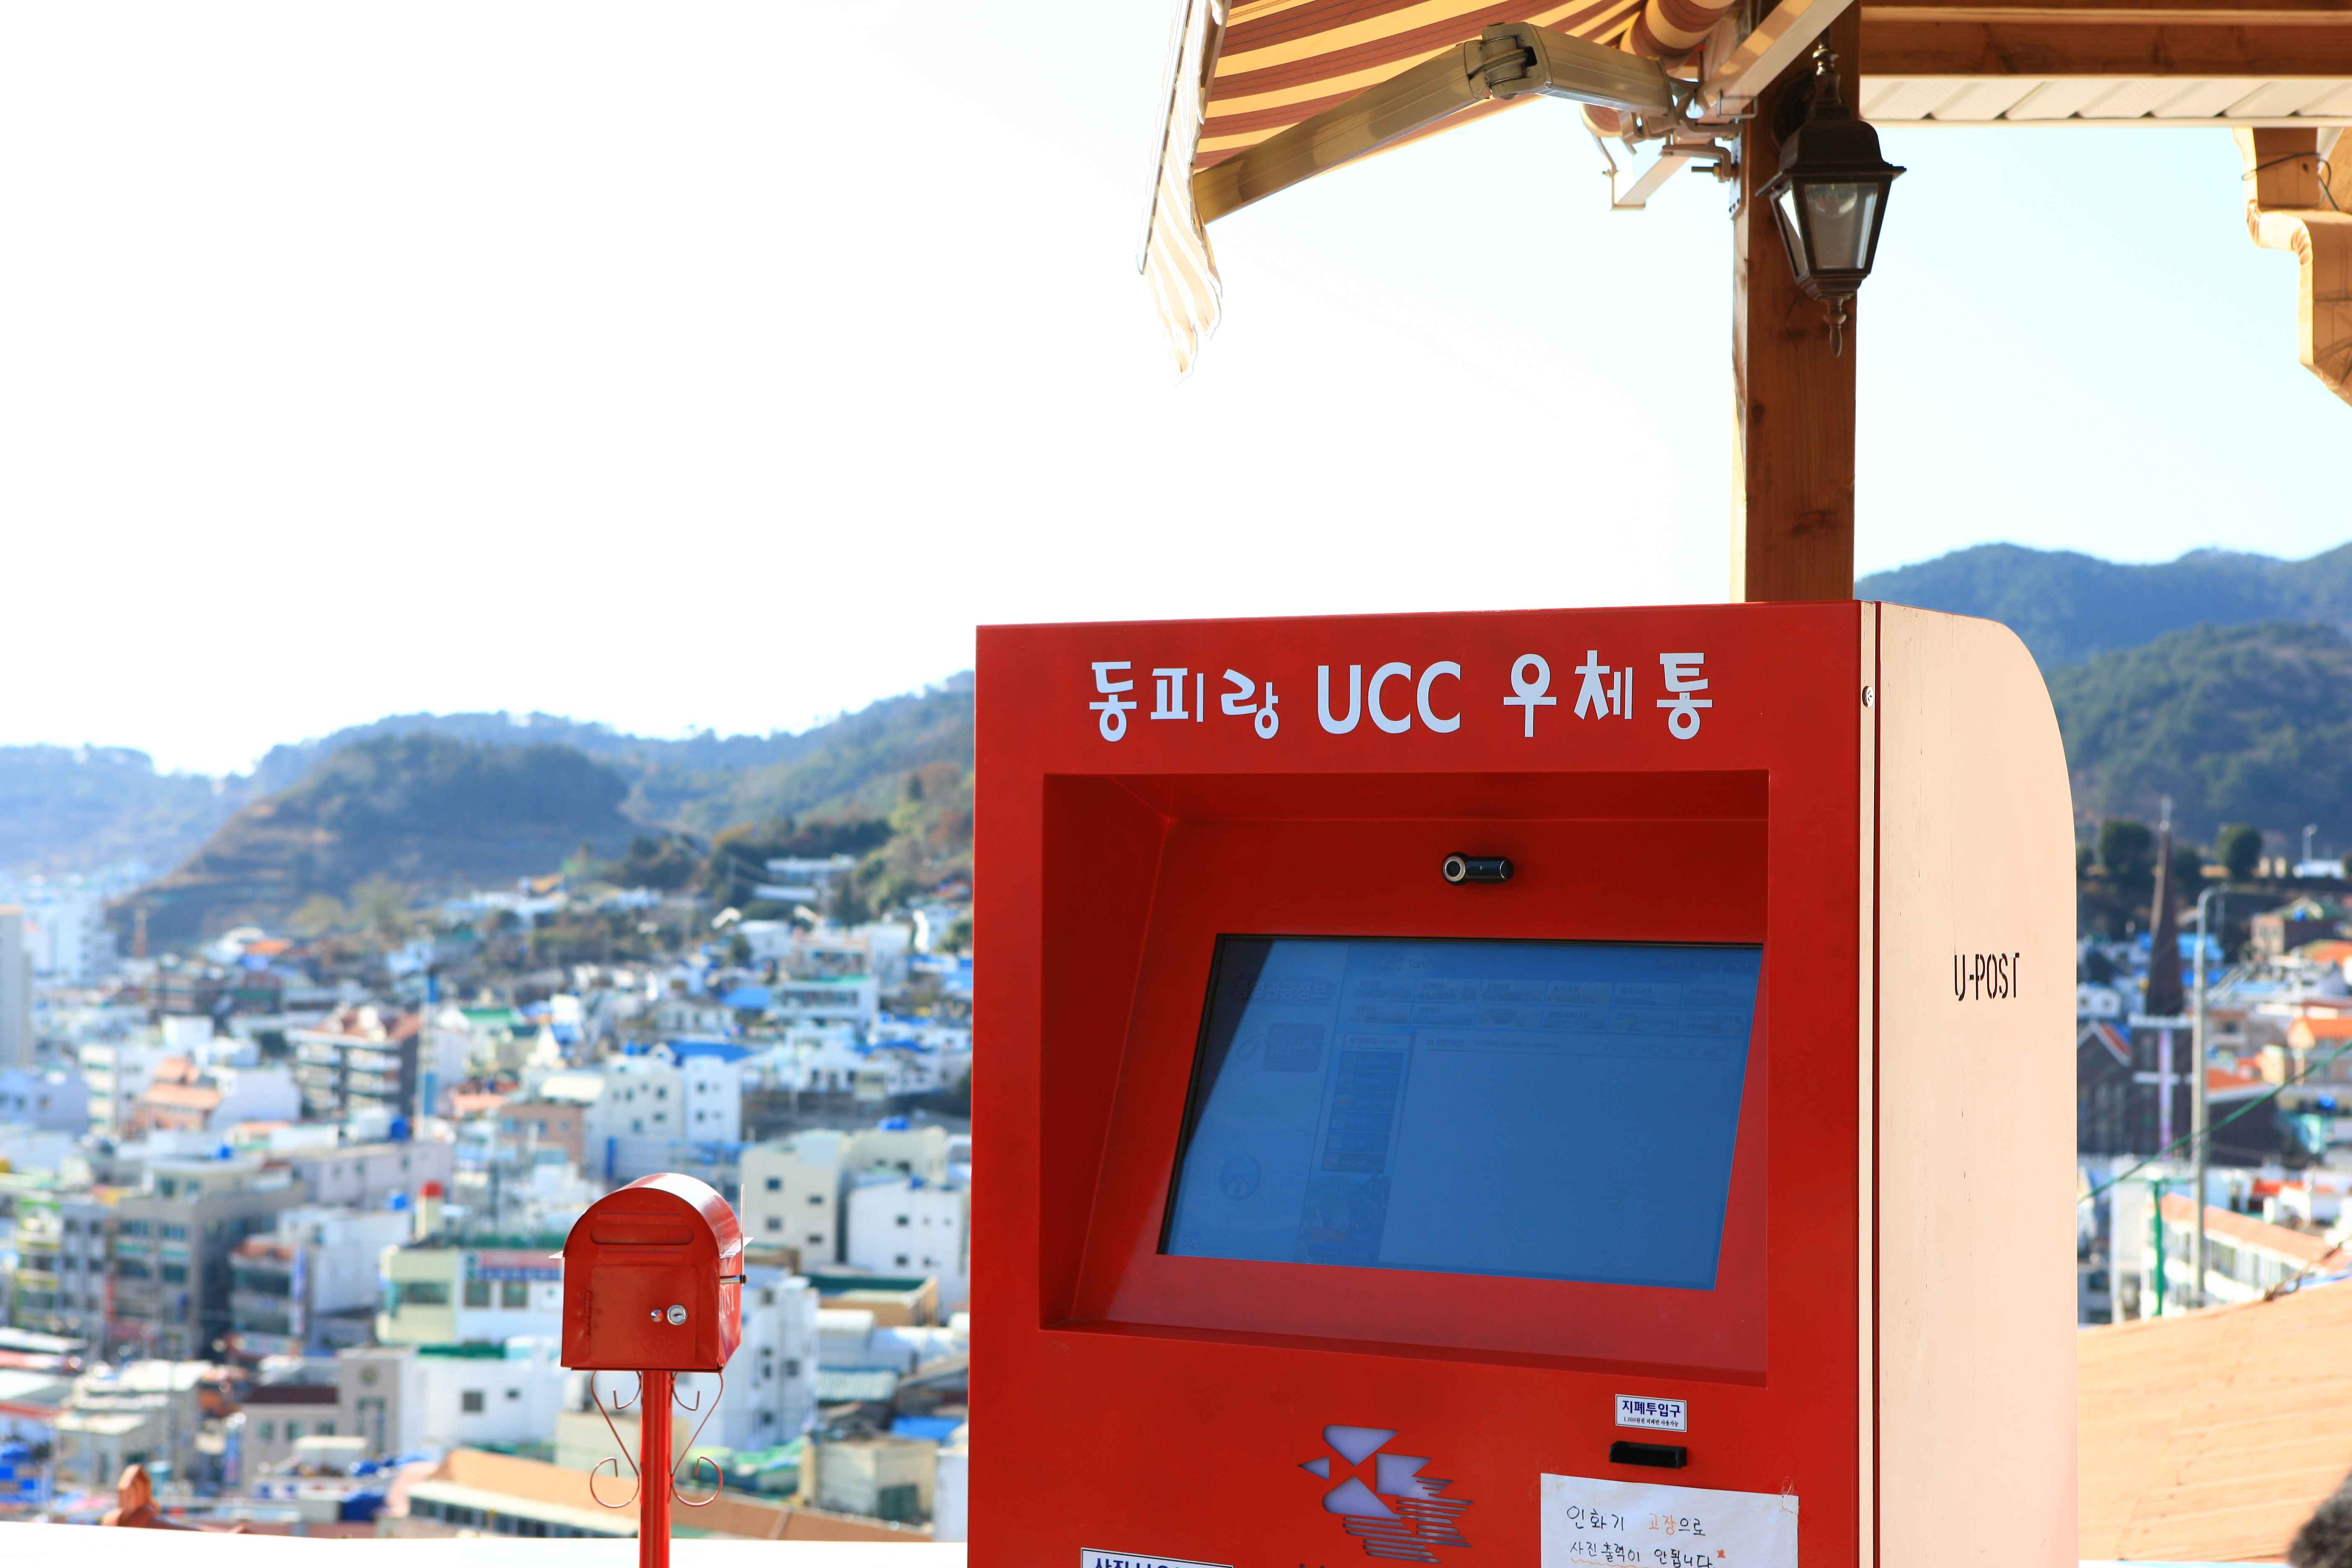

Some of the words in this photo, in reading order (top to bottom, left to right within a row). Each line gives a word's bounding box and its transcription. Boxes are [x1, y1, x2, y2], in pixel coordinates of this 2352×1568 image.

[1089, 660, 1279, 742] 동피랑
[1317, 660, 1461, 734] UCC
[1503, 650, 1712, 740] 우체통
[1954, 952, 2020, 1001] U-POST
[1622, 1400, 1681, 1418] 지폐투입구
[1567, 1506, 1625, 1531] 인화기
[1649, 1513, 1706, 1536] 고장으로
